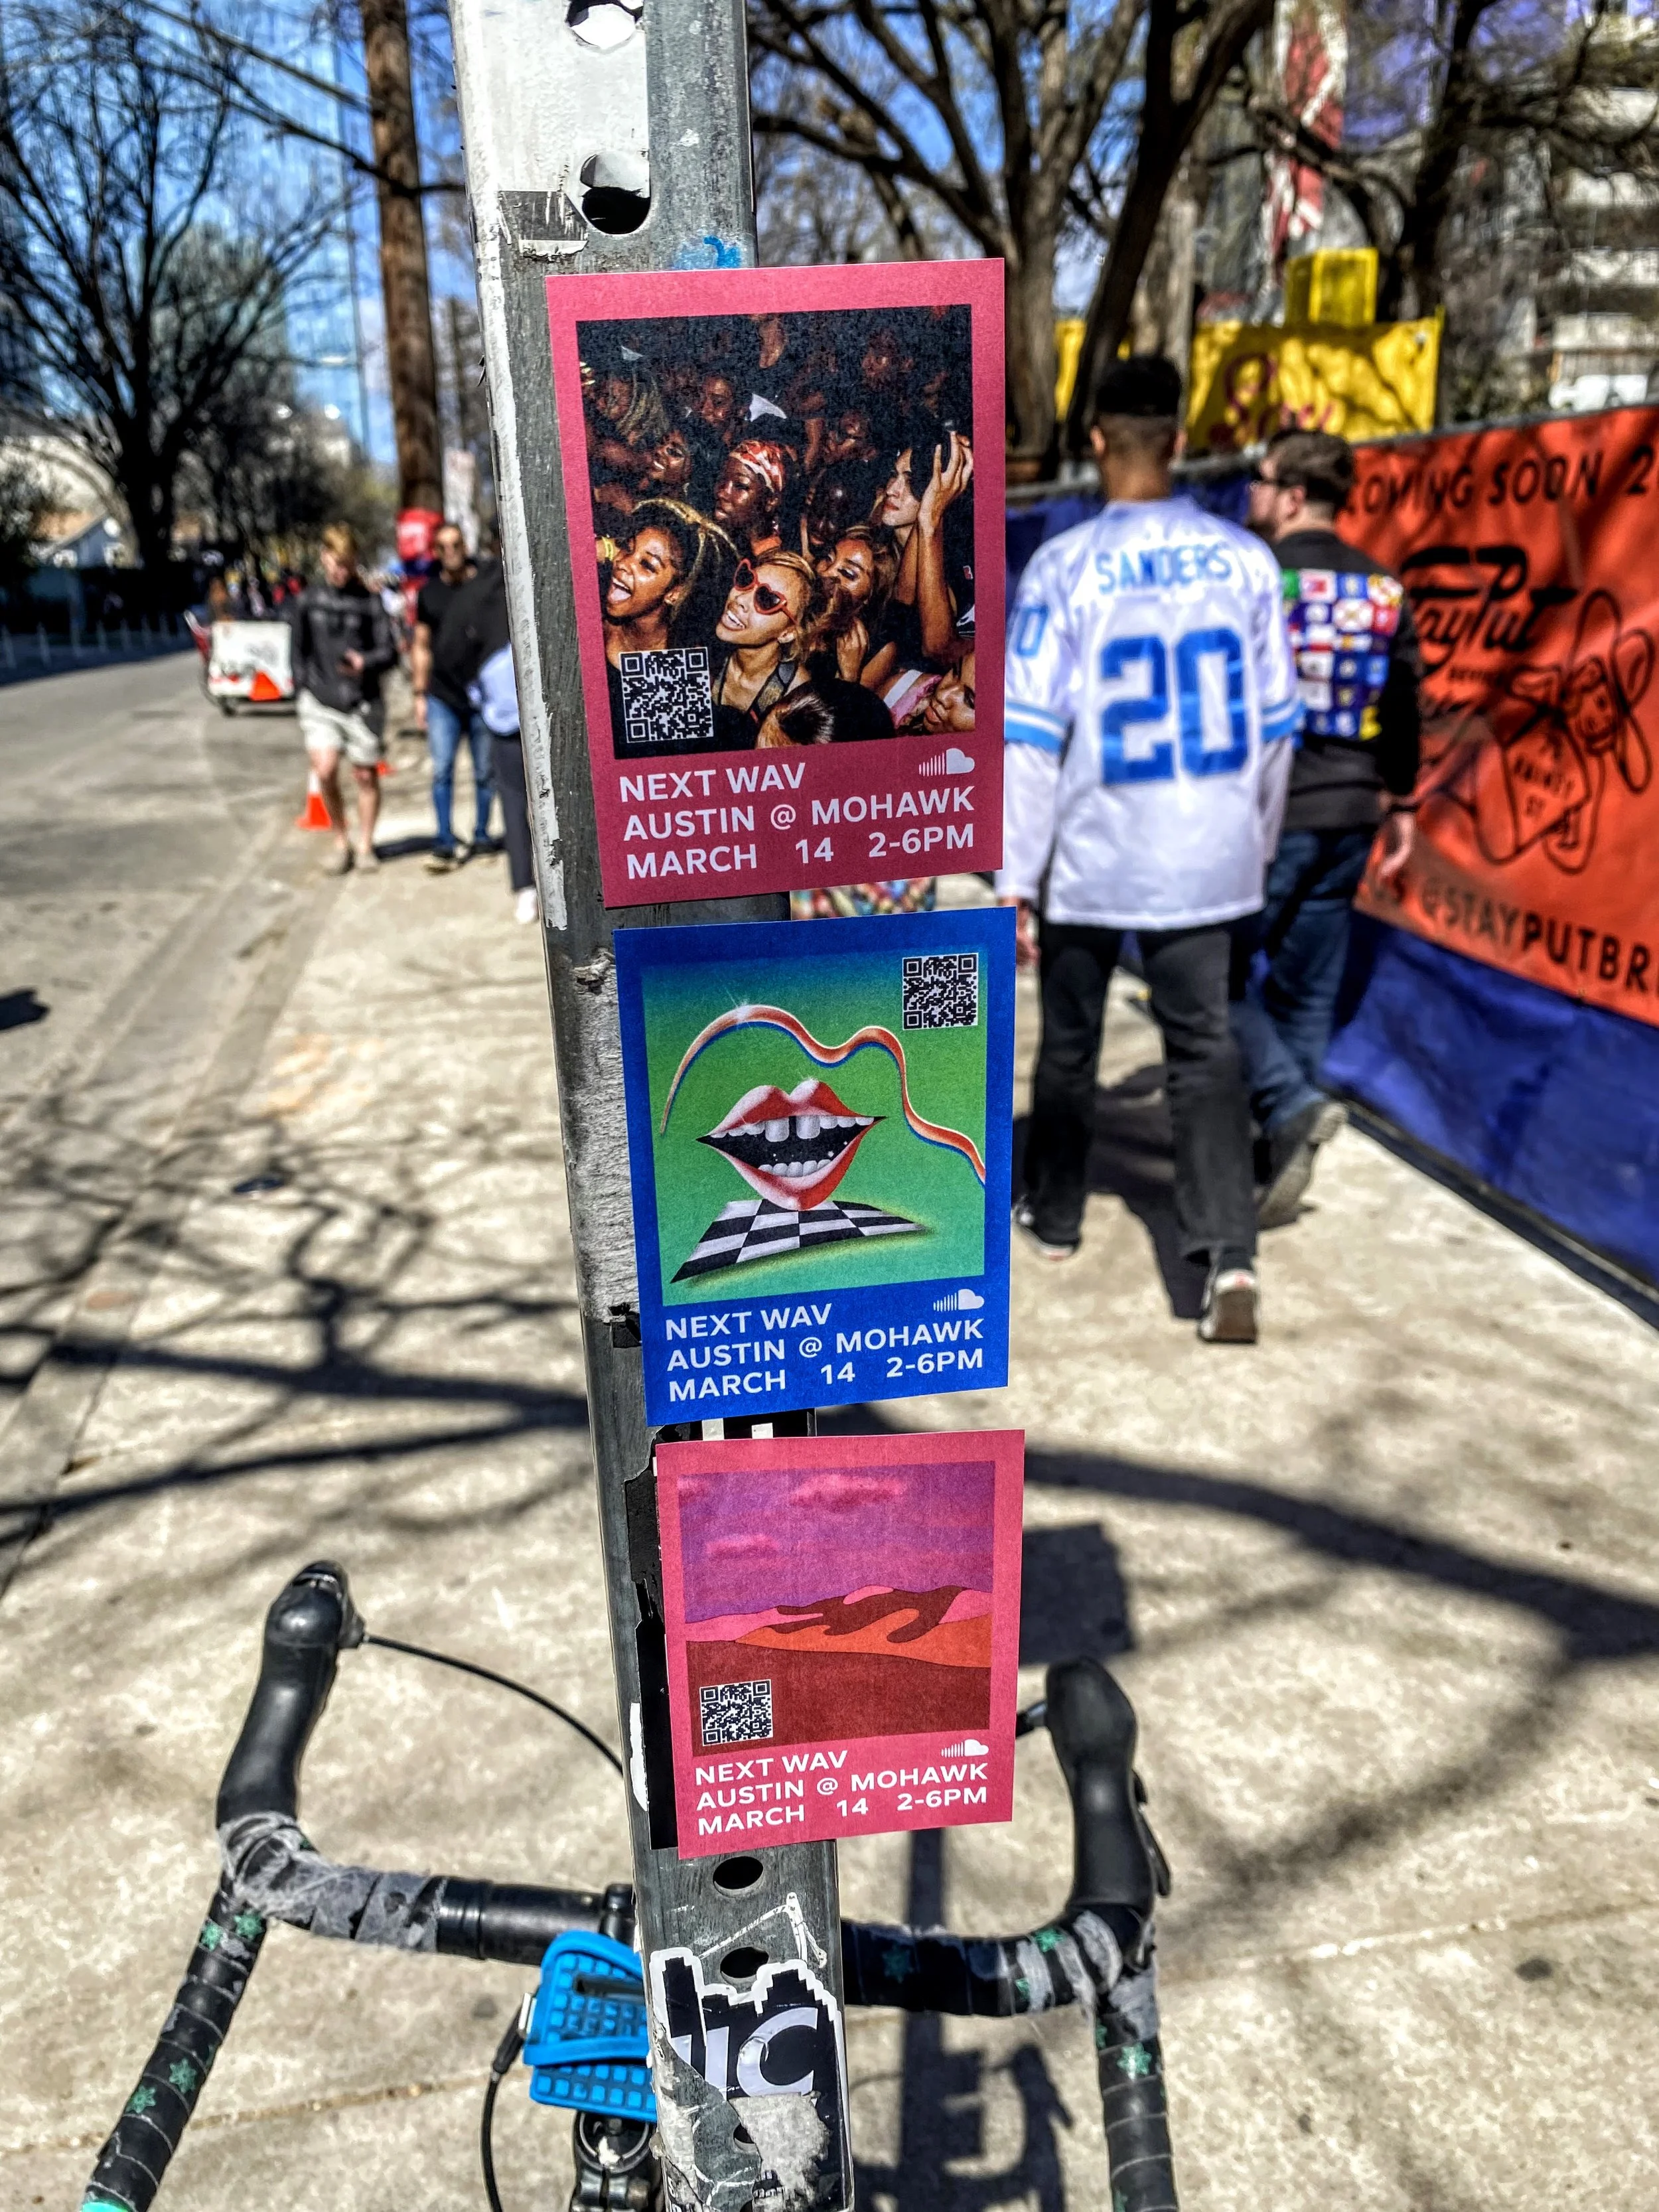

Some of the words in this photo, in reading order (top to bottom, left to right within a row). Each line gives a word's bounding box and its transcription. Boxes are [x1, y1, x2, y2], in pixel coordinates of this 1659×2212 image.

[1344, 463, 1474, 515] OMING
[1488, 447, 1604, 506] SOON
[1095, 540, 1232, 595] SANDERS
[1100, 627, 1249, 786] 20
[619, 769, 716, 802] NEXT
[725, 762, 806, 794] WAV
[623, 805, 755, 841] AUSTIN
[770, 804, 796, 831] @
[812, 785, 975, 826] MOHAWK
[627, 844, 757, 879] MARCH
[794, 837, 833, 863] 14
[868, 823, 974, 857] 2-6PM
[665, 1311, 752, 1341] NEXT
[760, 1302, 832, 1329] WAV
[666, 1339, 785, 1372] AUSTIN
[798, 1336, 822, 1359] @
[836, 1318, 984, 1354] MOHAWK
[668, 1369, 786, 1402] MARCH
[820, 1361, 855, 1385] 14
[886, 1348, 983, 1378] 2-6PM
[695, 1758, 774, 1786] NEXT
[781, 1750, 848, 1773] WAV
[696, 1779, 804, 1811] AUSTIN
[816, 1777, 839, 1795] @
[851, 1763, 989, 1792] MOHAWK
[698, 1804, 804, 1836] MARCH
[836, 1800, 869, 1816] 14
[897, 1786, 987, 1811] 2-6PM
